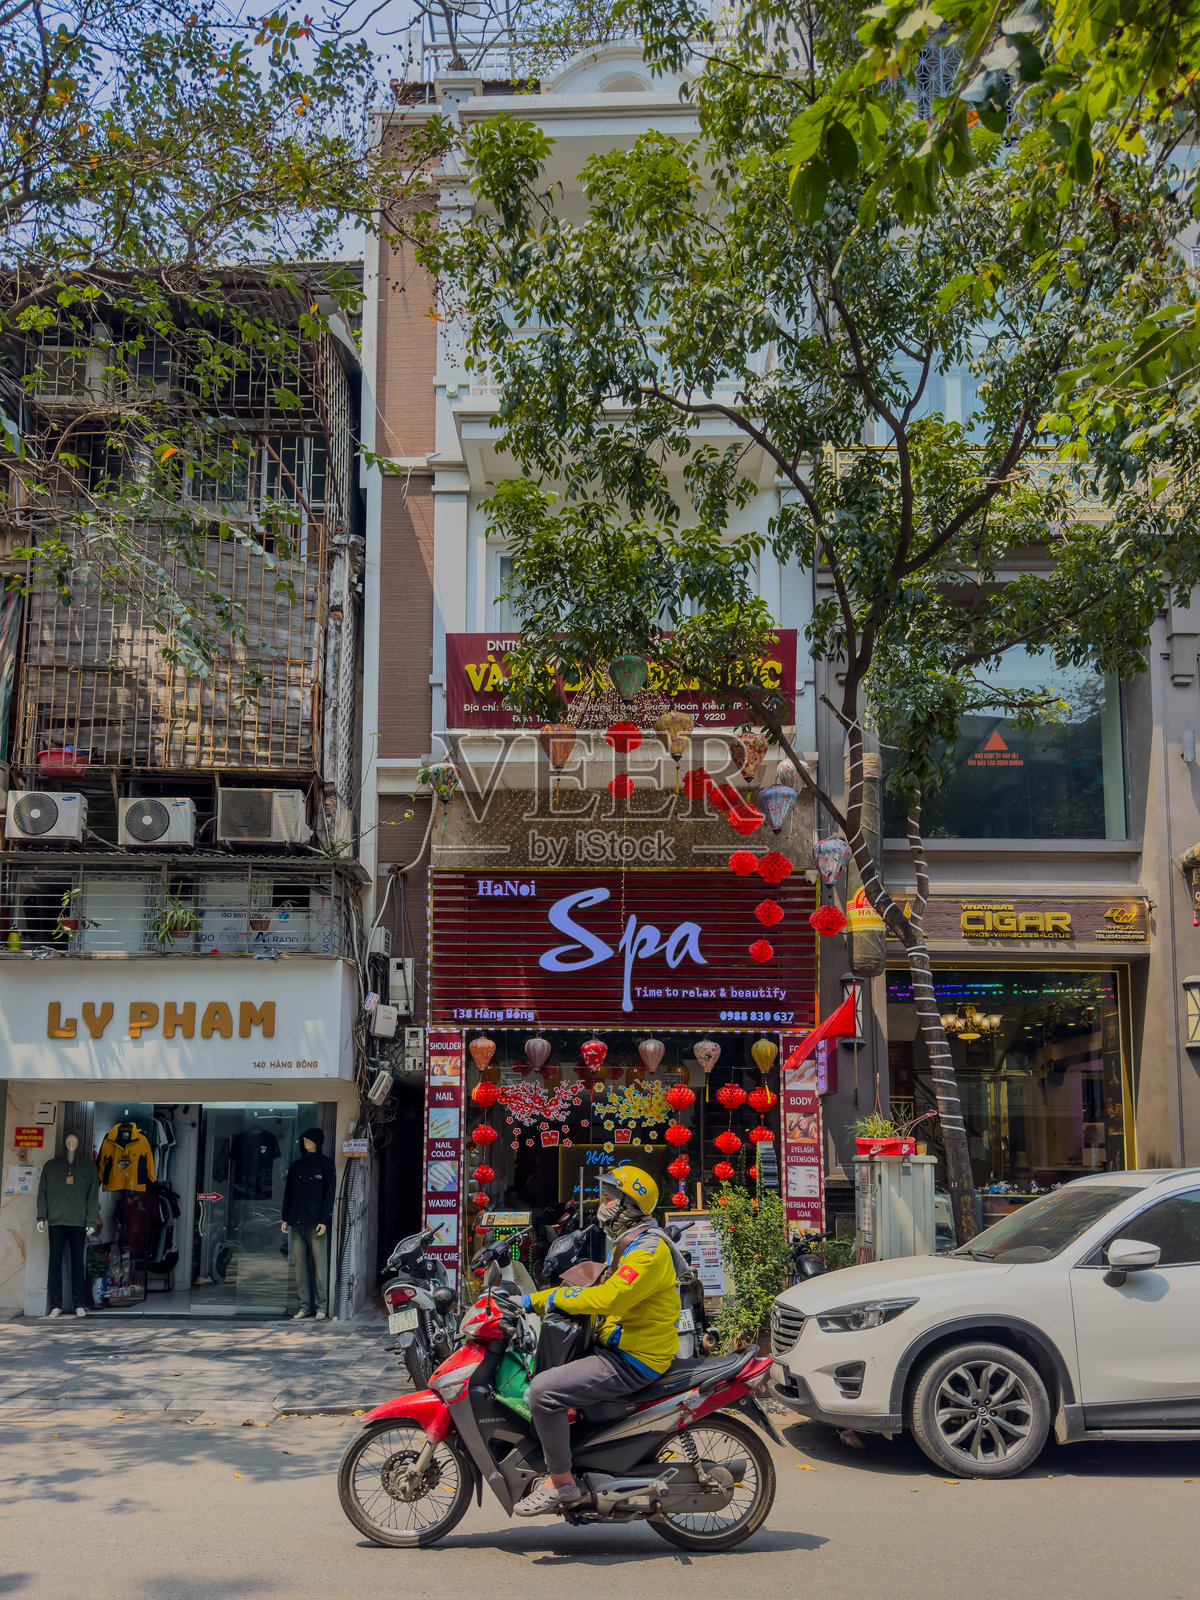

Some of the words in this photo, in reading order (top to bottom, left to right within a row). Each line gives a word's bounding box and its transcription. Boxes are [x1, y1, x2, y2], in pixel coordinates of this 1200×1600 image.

[463, 703, 480, 713] Địa
[704, 712, 727, 722] 9220
[477, 880, 536, 897] HaNoi
[960, 911, 1072, 932] CIGAR
[538, 886, 709, 1013] Spa
[635, 987, 663, 998] Time
[664, 988, 679, 998] to
[682, 987, 716, 998] relax
[719, 987, 728, 998] &
[730, 987, 787, 1001] beautify
[452, 1008, 473, 1019] 138
[474, 1008, 504, 1021] Hàng
[719, 1011, 748, 1021] 0988
[749, 1011, 772, 1021] 830
[773, 1011, 795, 1022] 637
[47, 1001, 114, 1039] LY
[128, 1001, 277, 1039] PHAM
[429, 1042, 462, 1050] SHOULDER
[252, 1061, 266, 1069] 140
[269, 1059, 293, 1069] HÀNG
[295, 1059, 319, 1069] BÔNG
[435, 1092, 454, 1101] NAIL
[790, 1096, 813, 1106] BODY
[435, 1141, 452, 1149] NAIL
[430, 1150, 457, 1158] COLOR
[786, 1155, 819, 1163] EXTENSIONS
[428, 1199, 457, 1208] WAXING
[786, 1201, 807, 1209] HERBAL
[807, 1201, 822, 1209] FOOT
[796, 1210, 812, 1218] SOAK
[443, 1252, 458, 1262] CARE
